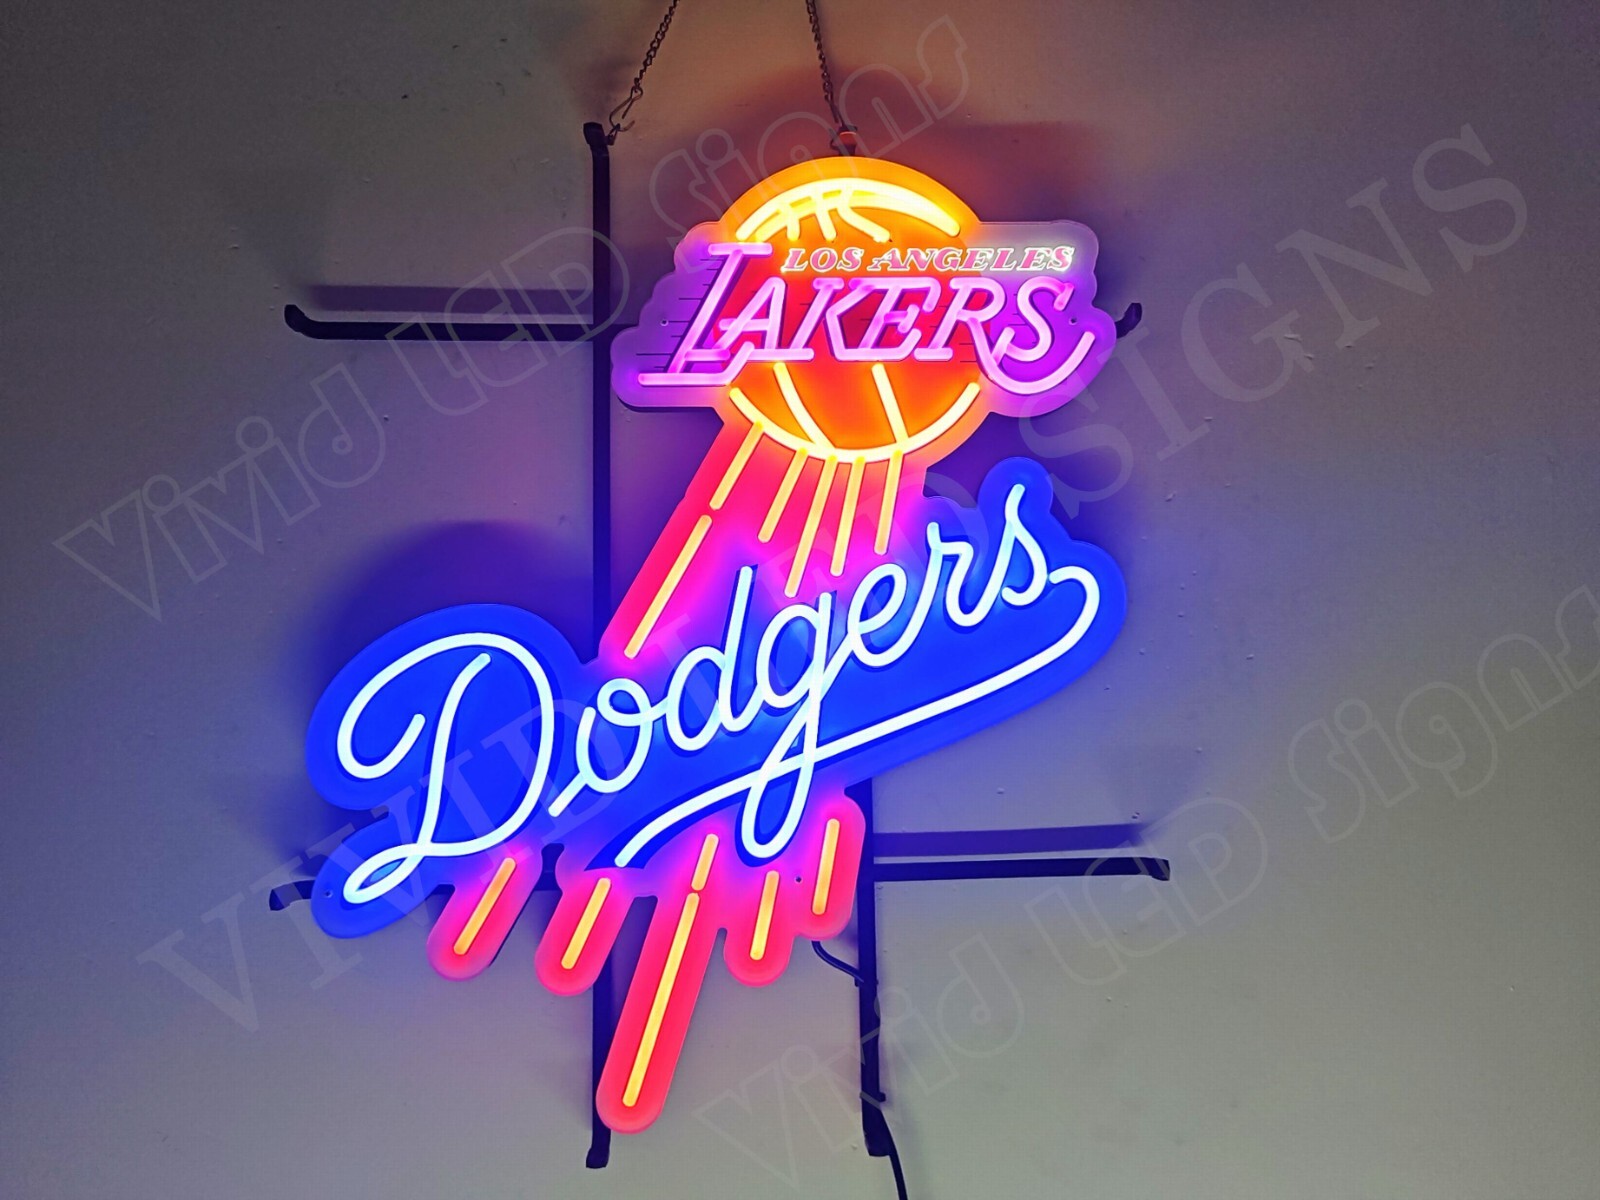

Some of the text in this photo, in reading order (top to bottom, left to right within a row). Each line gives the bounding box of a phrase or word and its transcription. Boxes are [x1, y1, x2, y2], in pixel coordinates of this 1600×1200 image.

[638, 242, 1096, 395] LAKERS
[781, 246, 1075, 272] LOS ANGELES
[336, 483, 1101, 906] Dodgers
